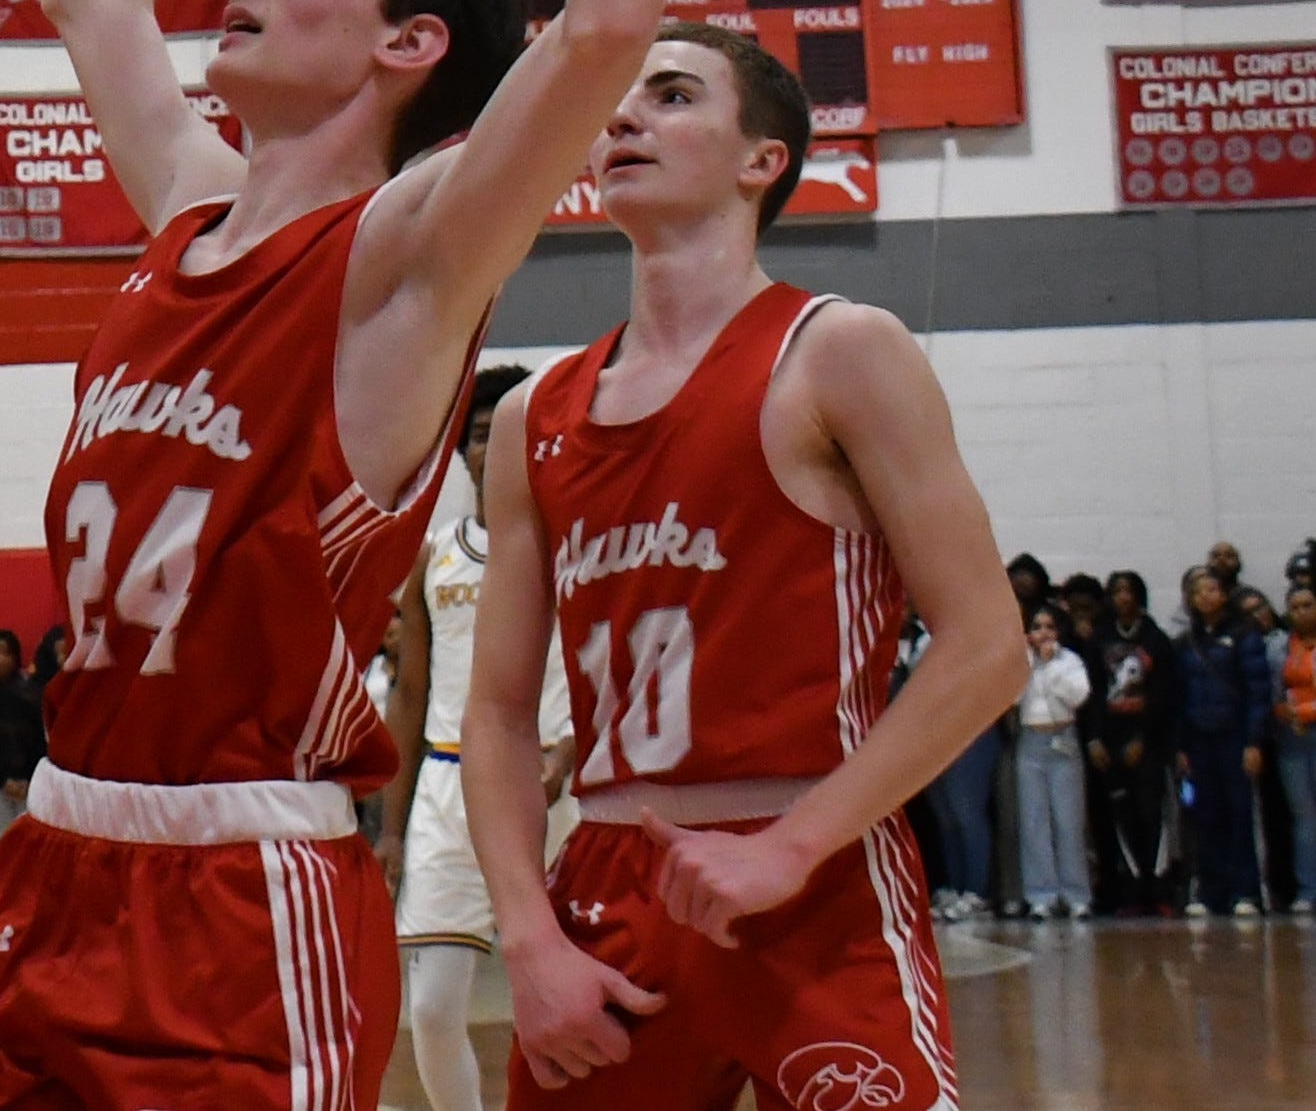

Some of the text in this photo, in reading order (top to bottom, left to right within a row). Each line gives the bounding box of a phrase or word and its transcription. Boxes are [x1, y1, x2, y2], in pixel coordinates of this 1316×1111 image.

[793, 7, 859, 28] FOULS
[1120, 56, 1227, 79] COLONIAL
[1140, 77, 1316, 109] CHAMPIO
[1131, 111, 1202, 134] GIRLS
[16, 159, 104, 183] GIRLS
[64, 362, 252, 462] Hawks
[554, 501, 728, 609] Hawks
[63, 480, 214, 676] 24
[577, 605, 695, 787] 10
